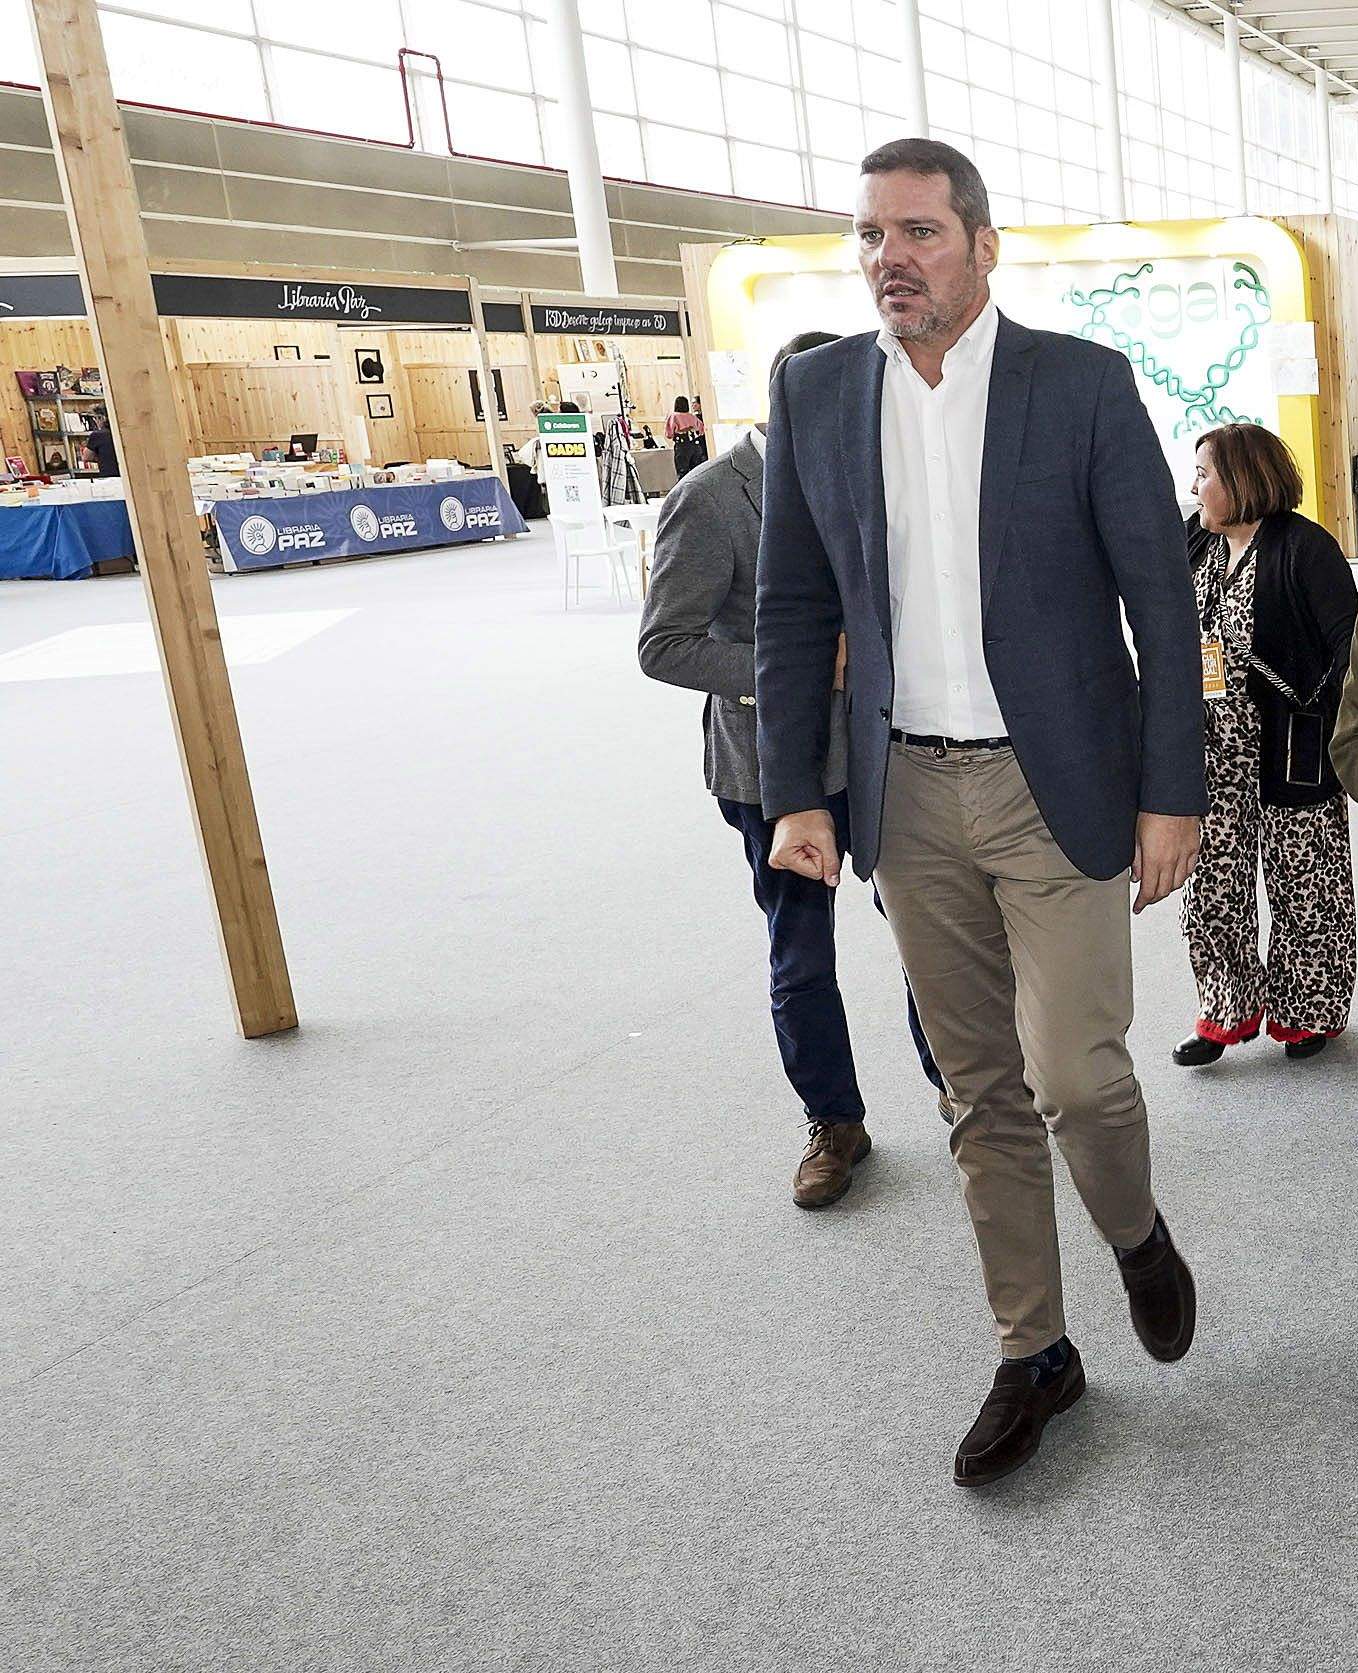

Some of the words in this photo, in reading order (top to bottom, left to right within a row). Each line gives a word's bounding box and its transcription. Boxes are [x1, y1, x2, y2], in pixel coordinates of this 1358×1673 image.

[338, 285, 382, 319] Paz
[547, 443, 585, 456] GADIS
[378, 513, 415, 524] LIBRARIA
[466, 511, 502, 529] PAZ
[276, 523, 322, 536] LIBRARIA
[380, 521, 418, 539] PAZ
[278, 531, 326, 551] PAZ
